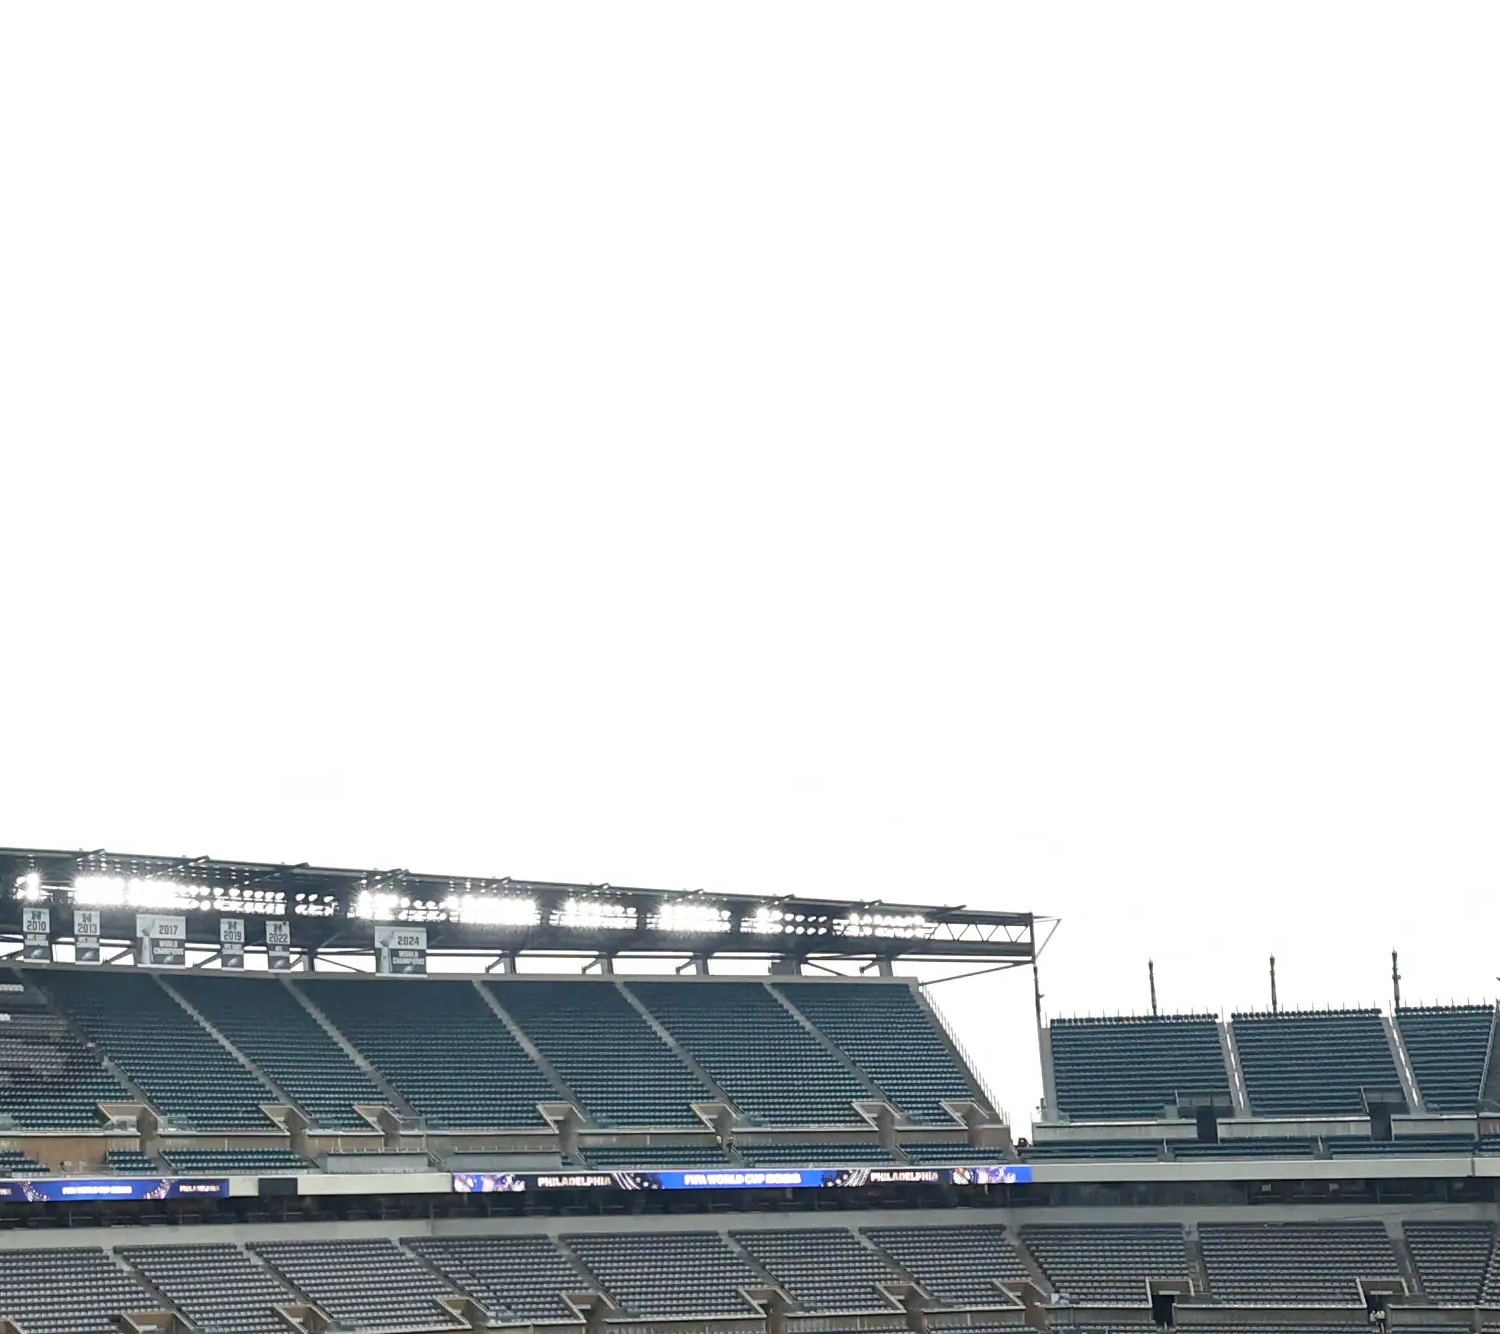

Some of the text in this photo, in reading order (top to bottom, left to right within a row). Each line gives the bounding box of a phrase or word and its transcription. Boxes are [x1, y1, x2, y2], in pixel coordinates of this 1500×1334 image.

[159, 925, 179, 936] 2017
[269, 932, 289, 943] 2022
[397, 936, 420, 946] 2024
[537, 1177, 612, 1187] PHILADELPHIA
